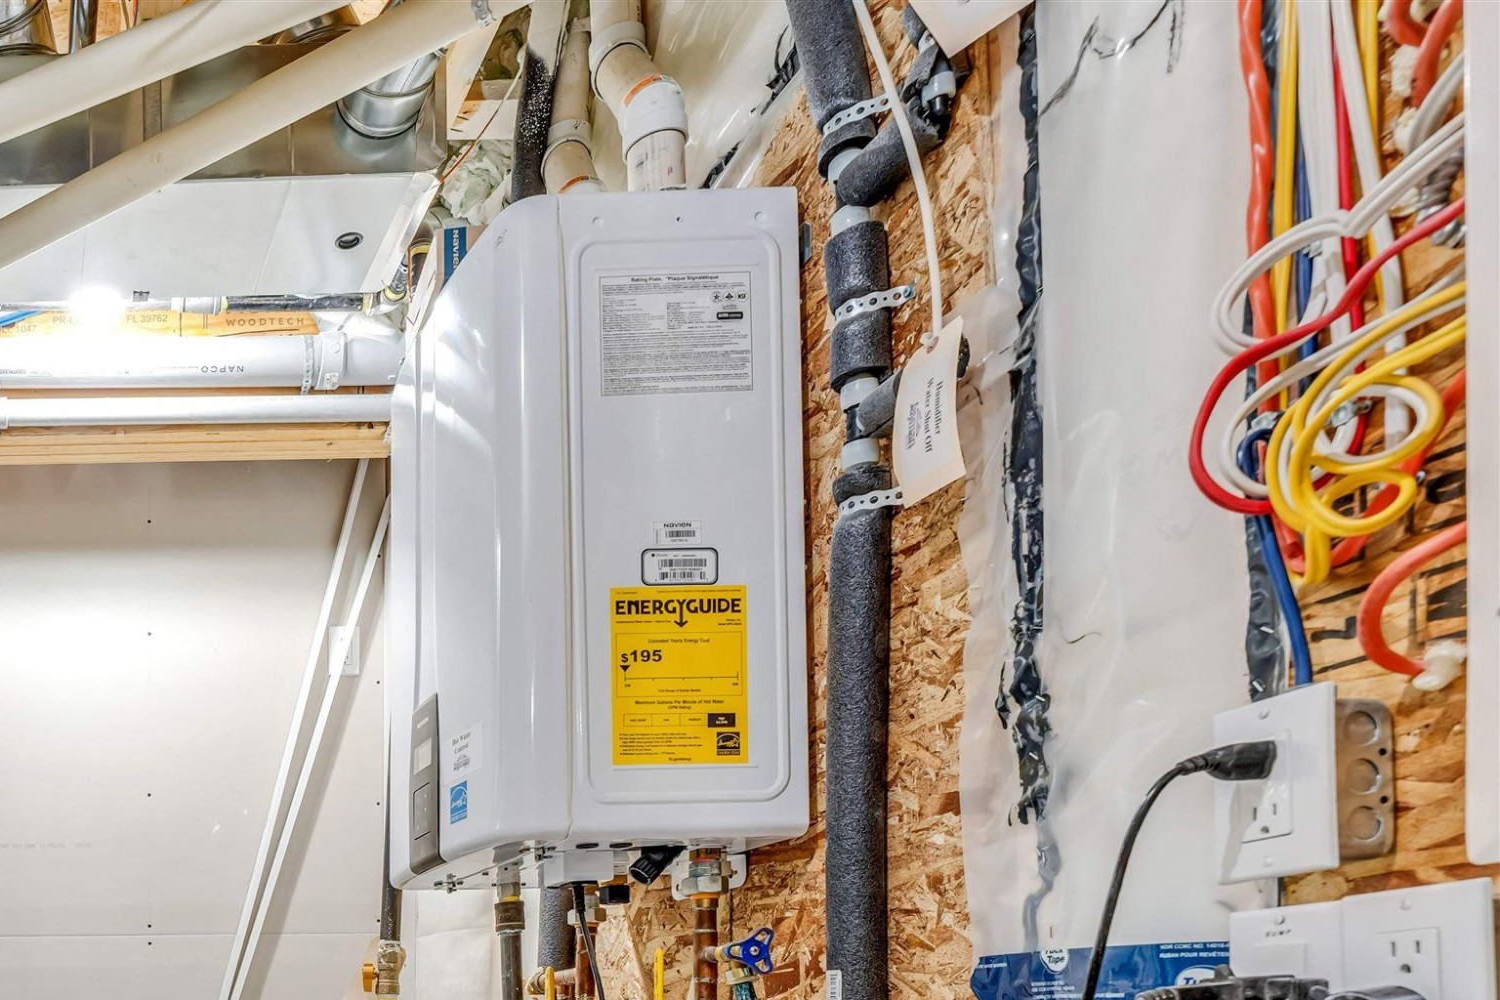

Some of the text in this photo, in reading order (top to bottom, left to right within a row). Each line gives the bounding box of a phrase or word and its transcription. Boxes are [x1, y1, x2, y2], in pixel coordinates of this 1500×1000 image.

[226, 316, 304, 327] WOODTECH
[201, 365, 244, 373] NAPCO
[935, 380, 944, 434] Humidifier
[924, 377, 934, 452] Water Shut Off
[615, 598, 741, 616] ENERGYGUIDE
[621, 649, 662, 663] $195
[1046, 954, 1065, 965] Tape
